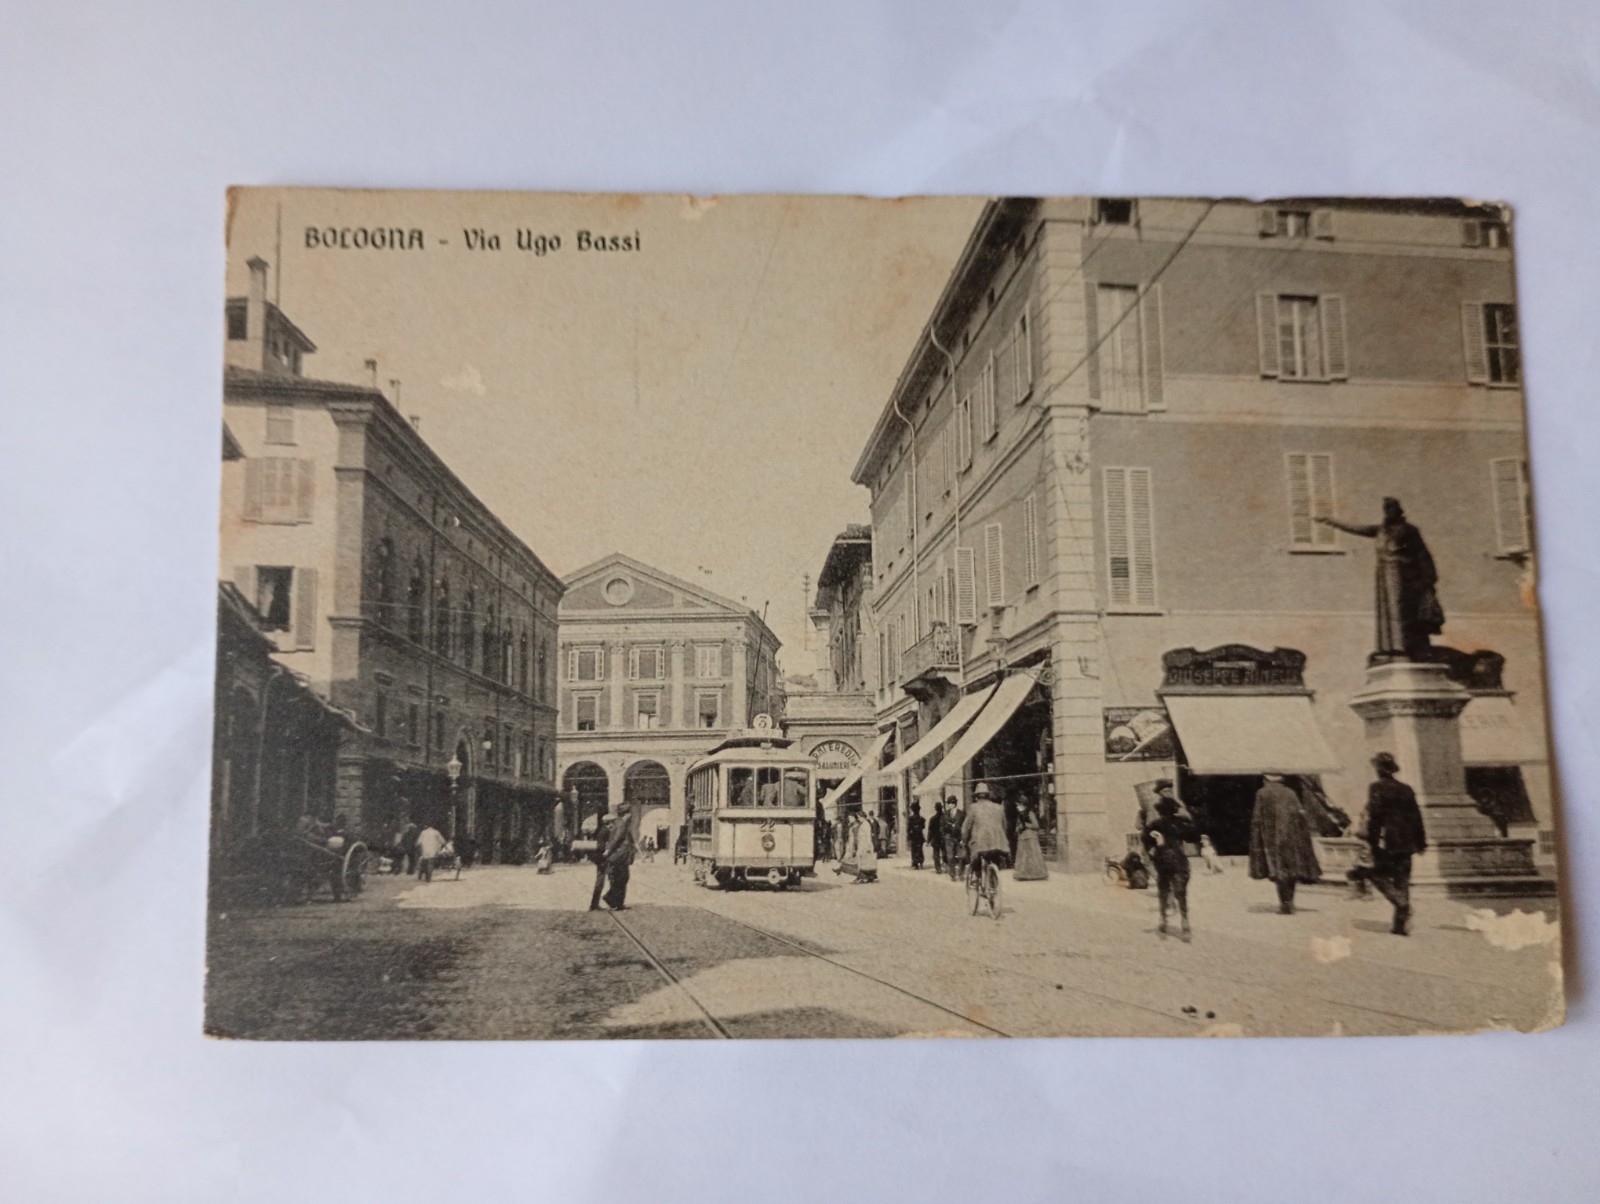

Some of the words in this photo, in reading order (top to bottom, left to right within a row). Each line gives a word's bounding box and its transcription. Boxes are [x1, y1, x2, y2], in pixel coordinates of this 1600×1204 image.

[305, 226, 425, 250] BOLOGNA
[463, 228, 501, 251] Via
[516, 228, 562, 257] Ugo
[576, 228, 642, 251] Bassi
